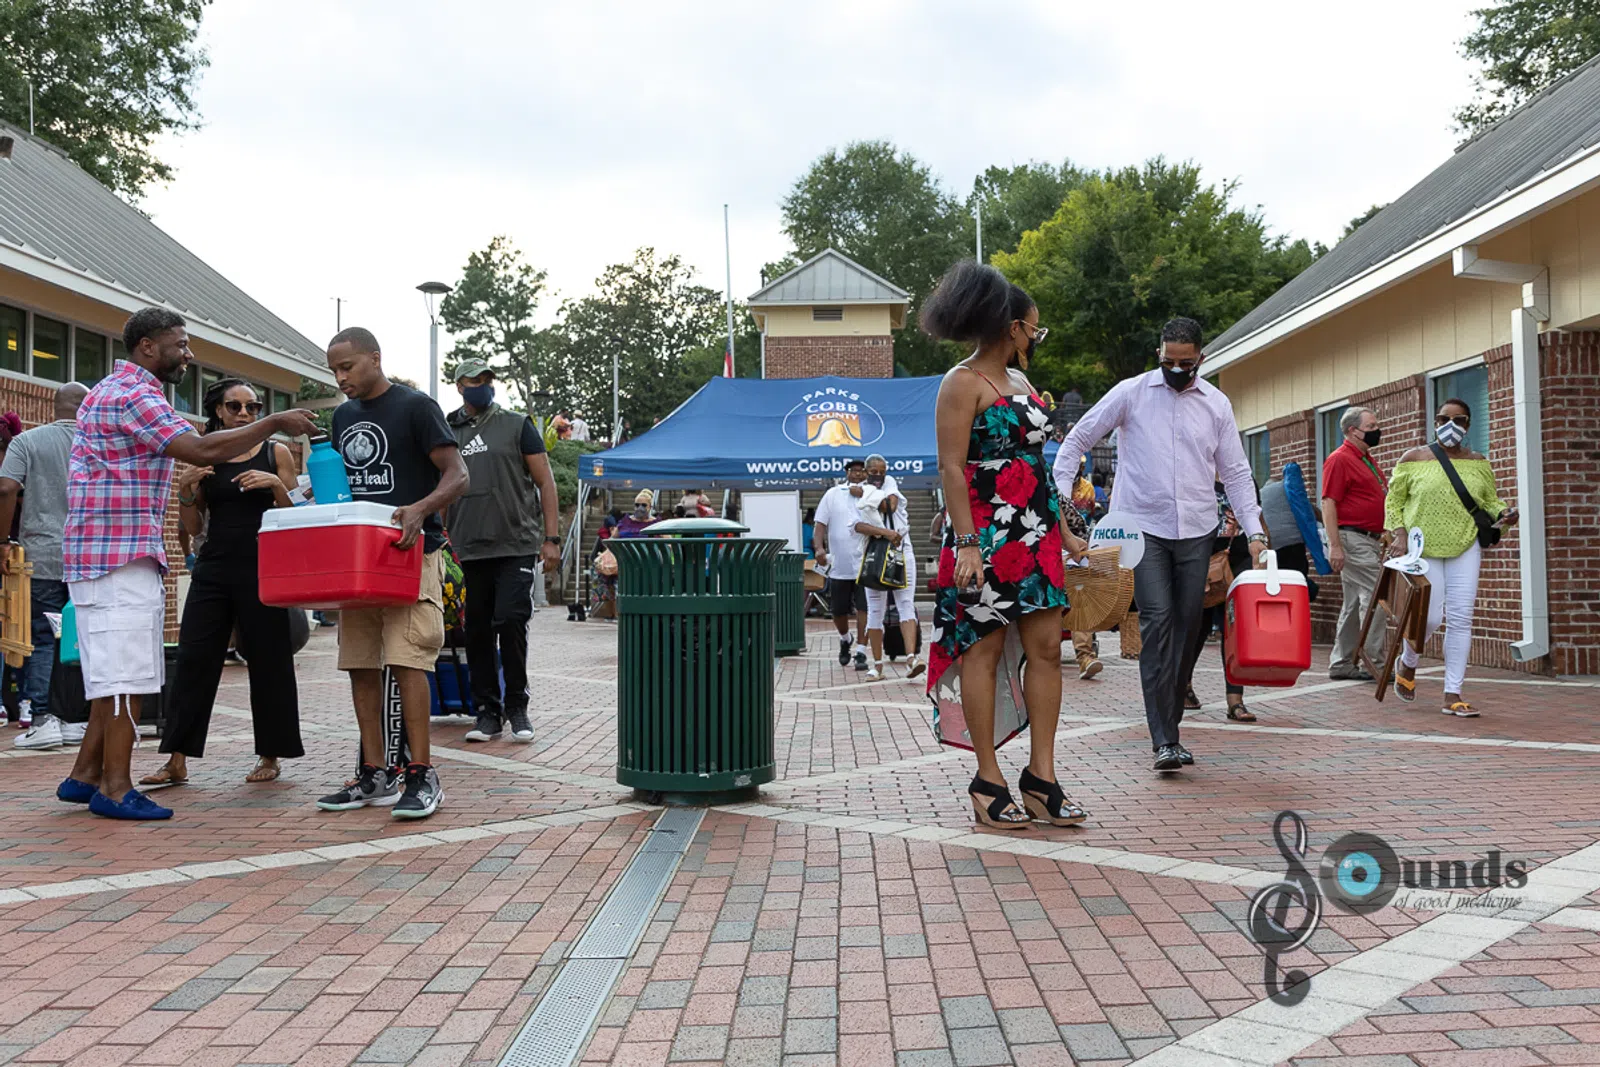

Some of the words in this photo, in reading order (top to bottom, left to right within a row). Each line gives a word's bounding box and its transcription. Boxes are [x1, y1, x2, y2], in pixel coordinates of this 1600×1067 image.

[802, 386, 860, 402] PARKS
[805, 401, 859, 413] COBB
[808, 412, 858, 420] COUNTY
[461, 444, 488, 456] adidas
[363, 469, 389, 485] lead
[1093, 528, 1139, 540] FHCGA.org
